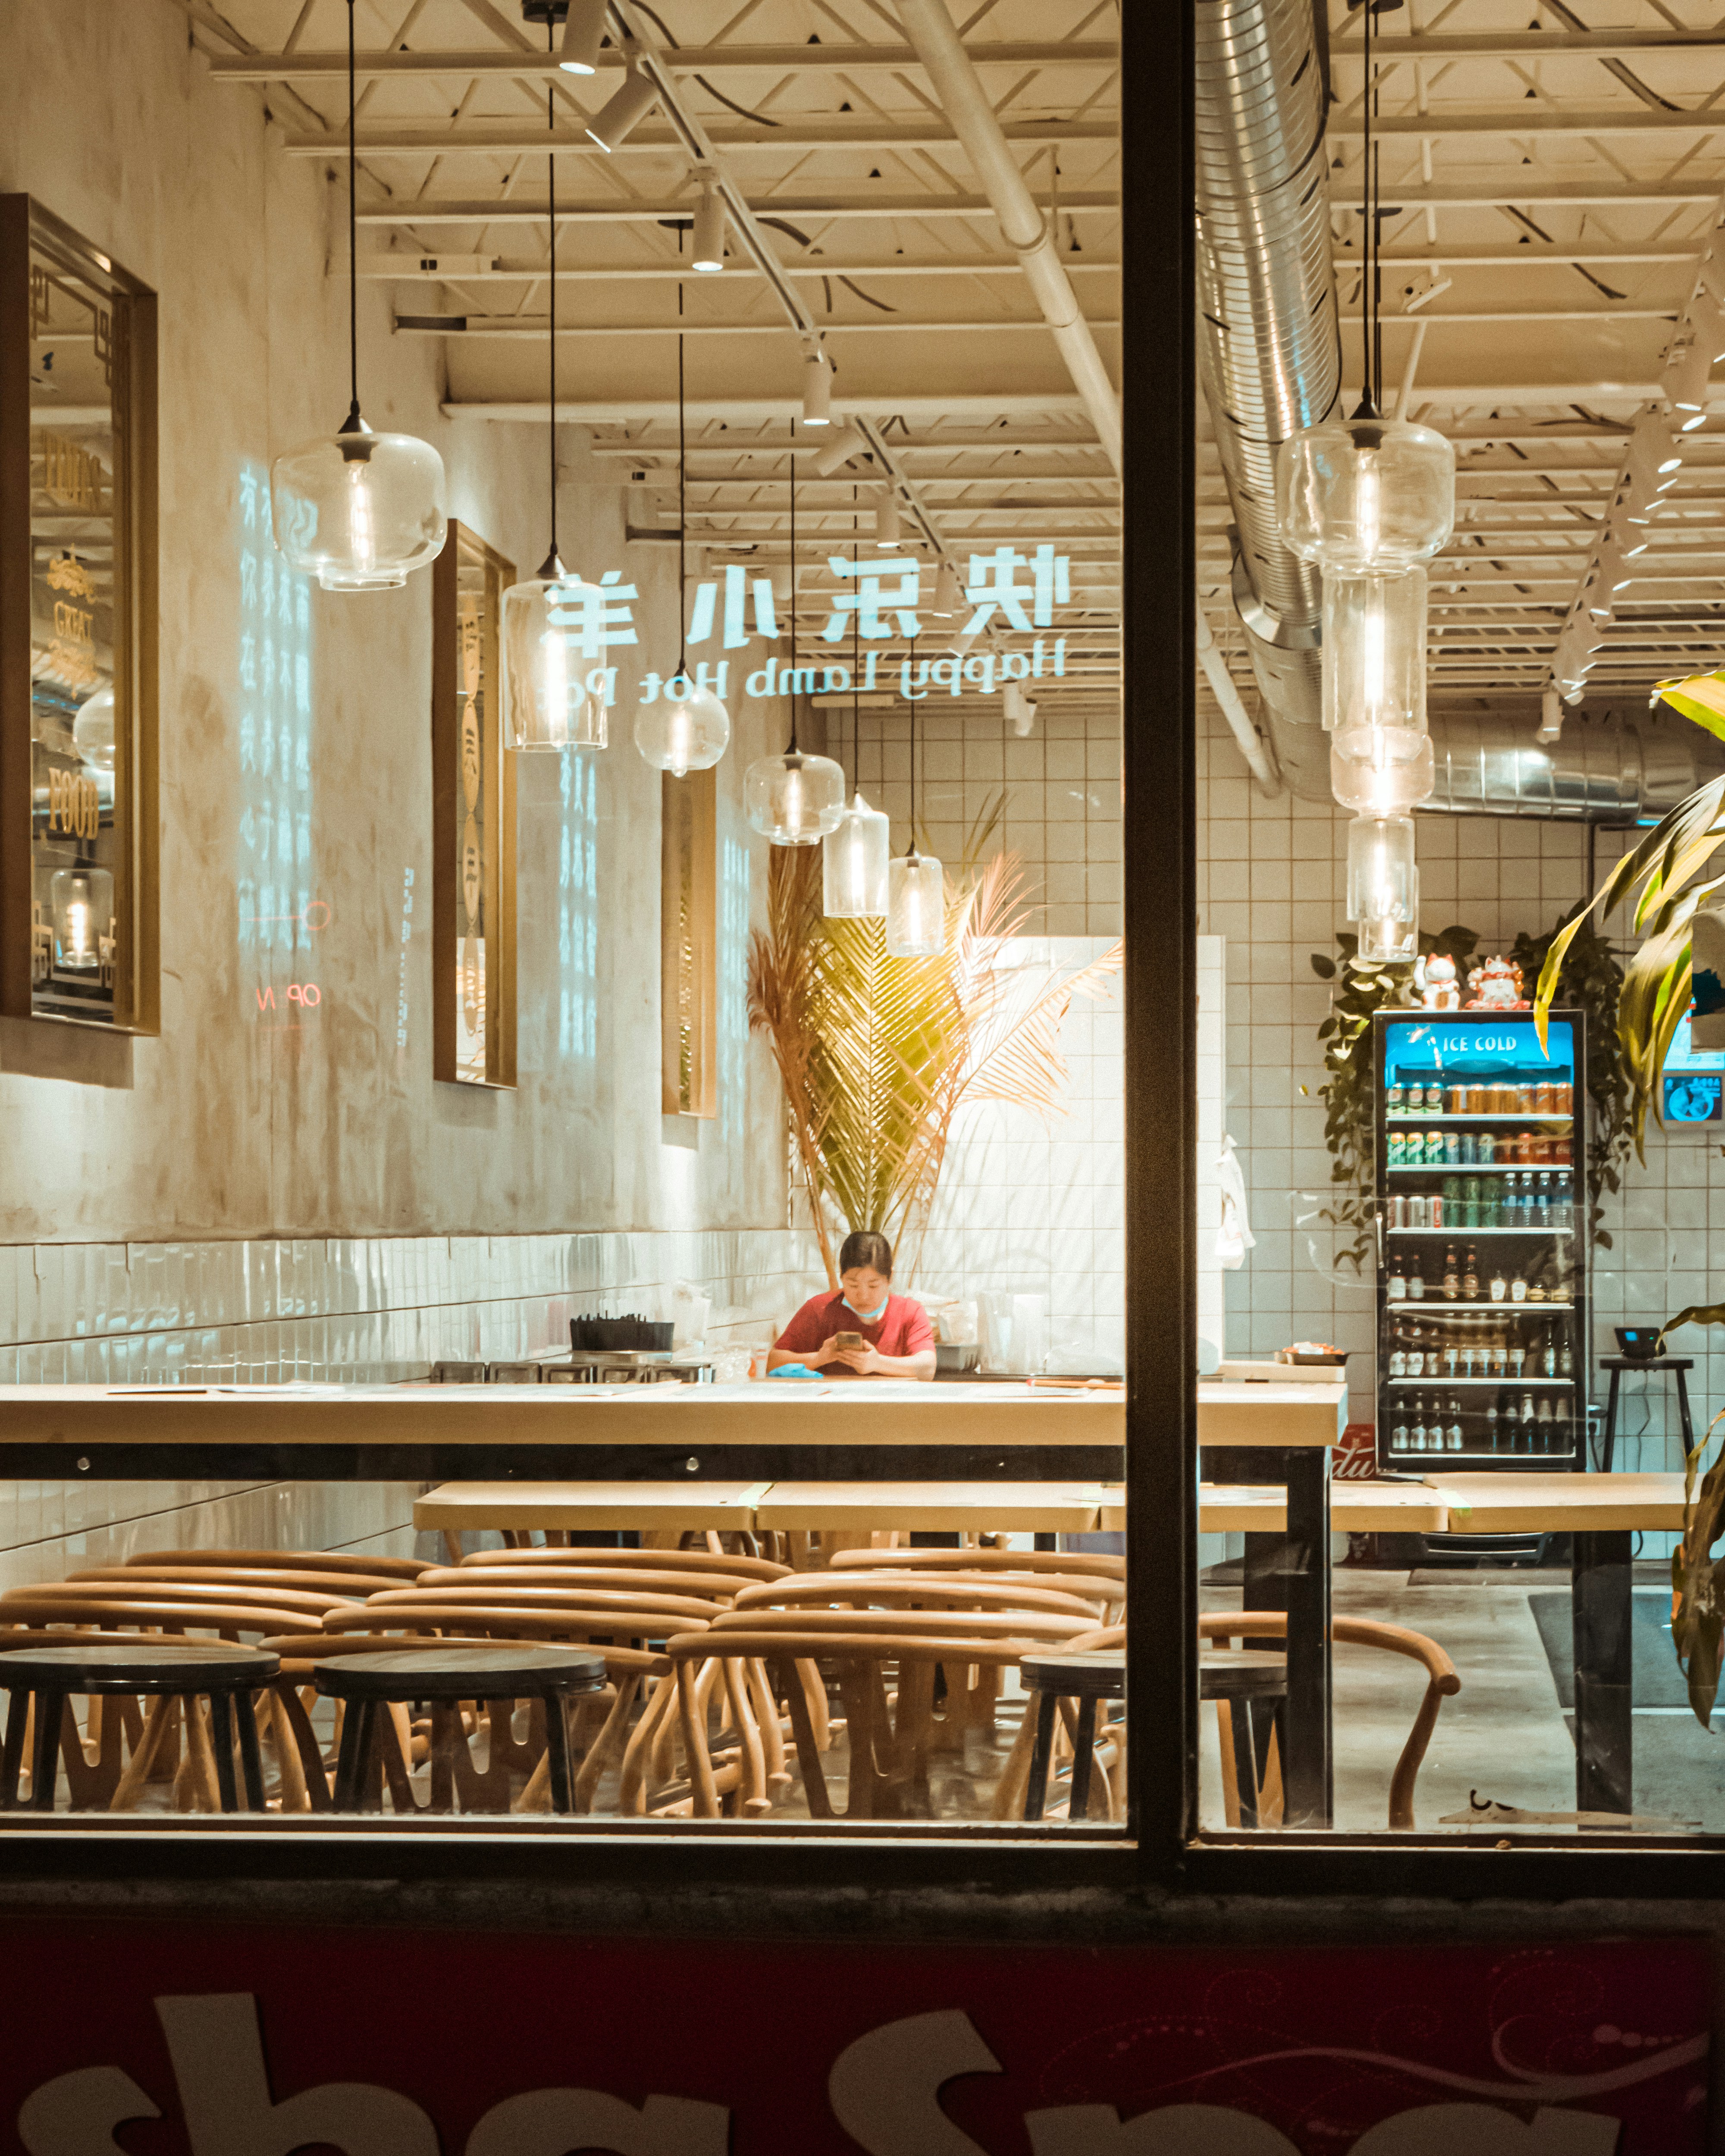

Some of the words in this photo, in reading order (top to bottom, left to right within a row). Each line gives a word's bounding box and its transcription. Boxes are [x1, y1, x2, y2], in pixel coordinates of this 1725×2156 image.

[49, 767, 99, 840] FOOD
[1443, 1037, 1468, 1052] ICE
[1475, 1037, 1517, 1051] COLD
